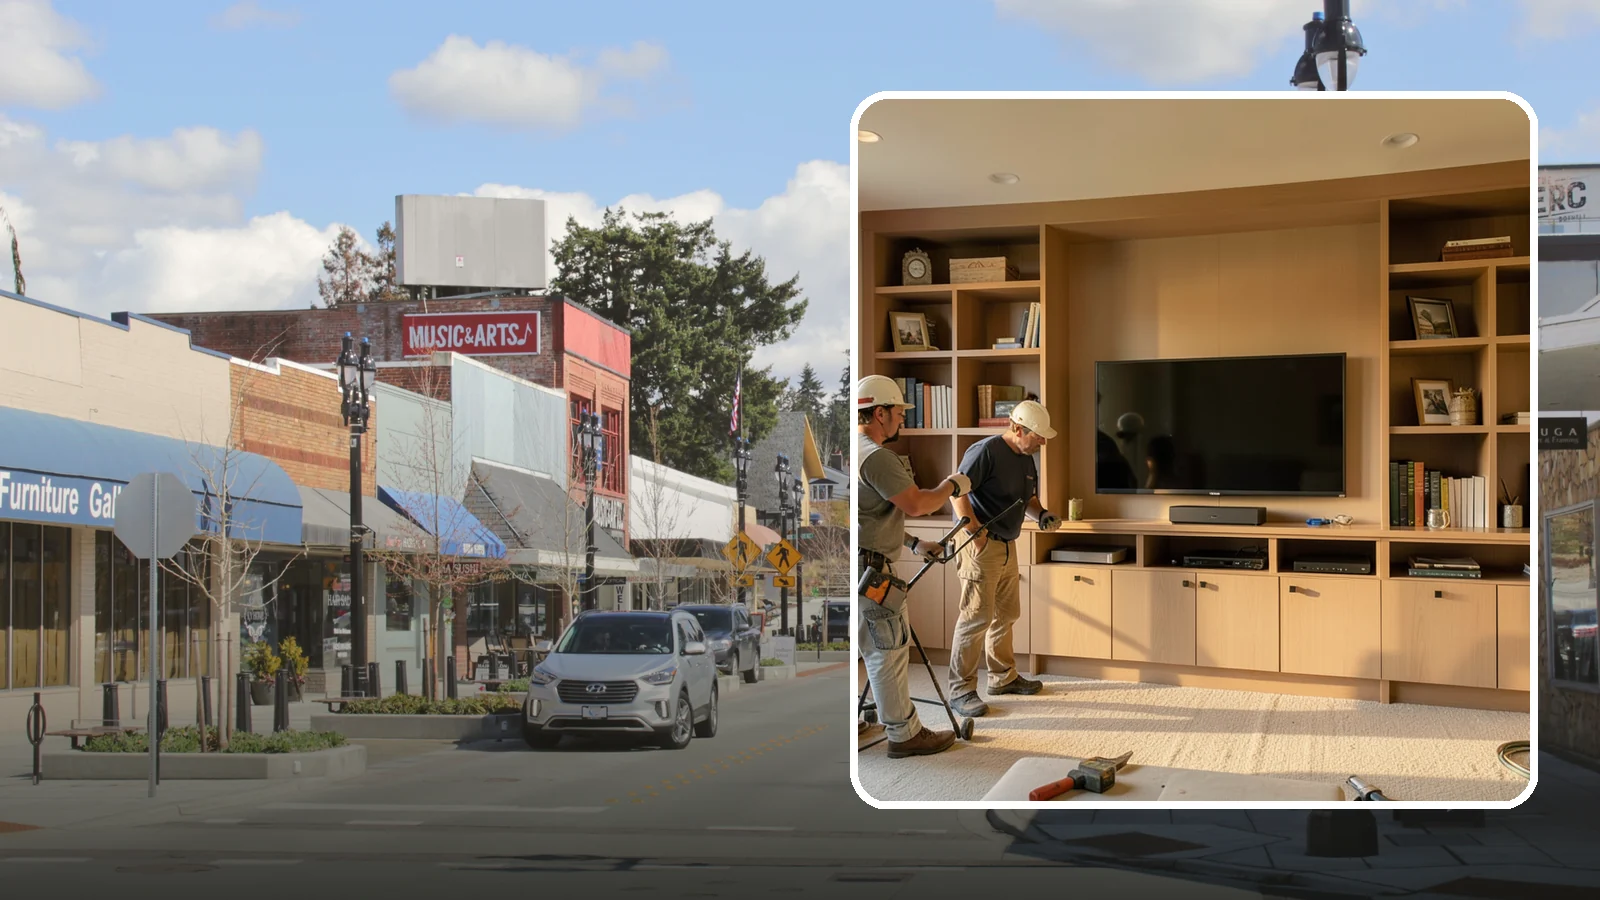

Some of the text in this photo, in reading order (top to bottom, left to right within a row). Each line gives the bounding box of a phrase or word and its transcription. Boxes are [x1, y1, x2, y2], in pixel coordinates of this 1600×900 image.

[409, 323, 519, 349] MUSIC&ARTS
[0, 471, 121, 519] Furniture Gal
[454, 563, 479, 574] SUSHI
